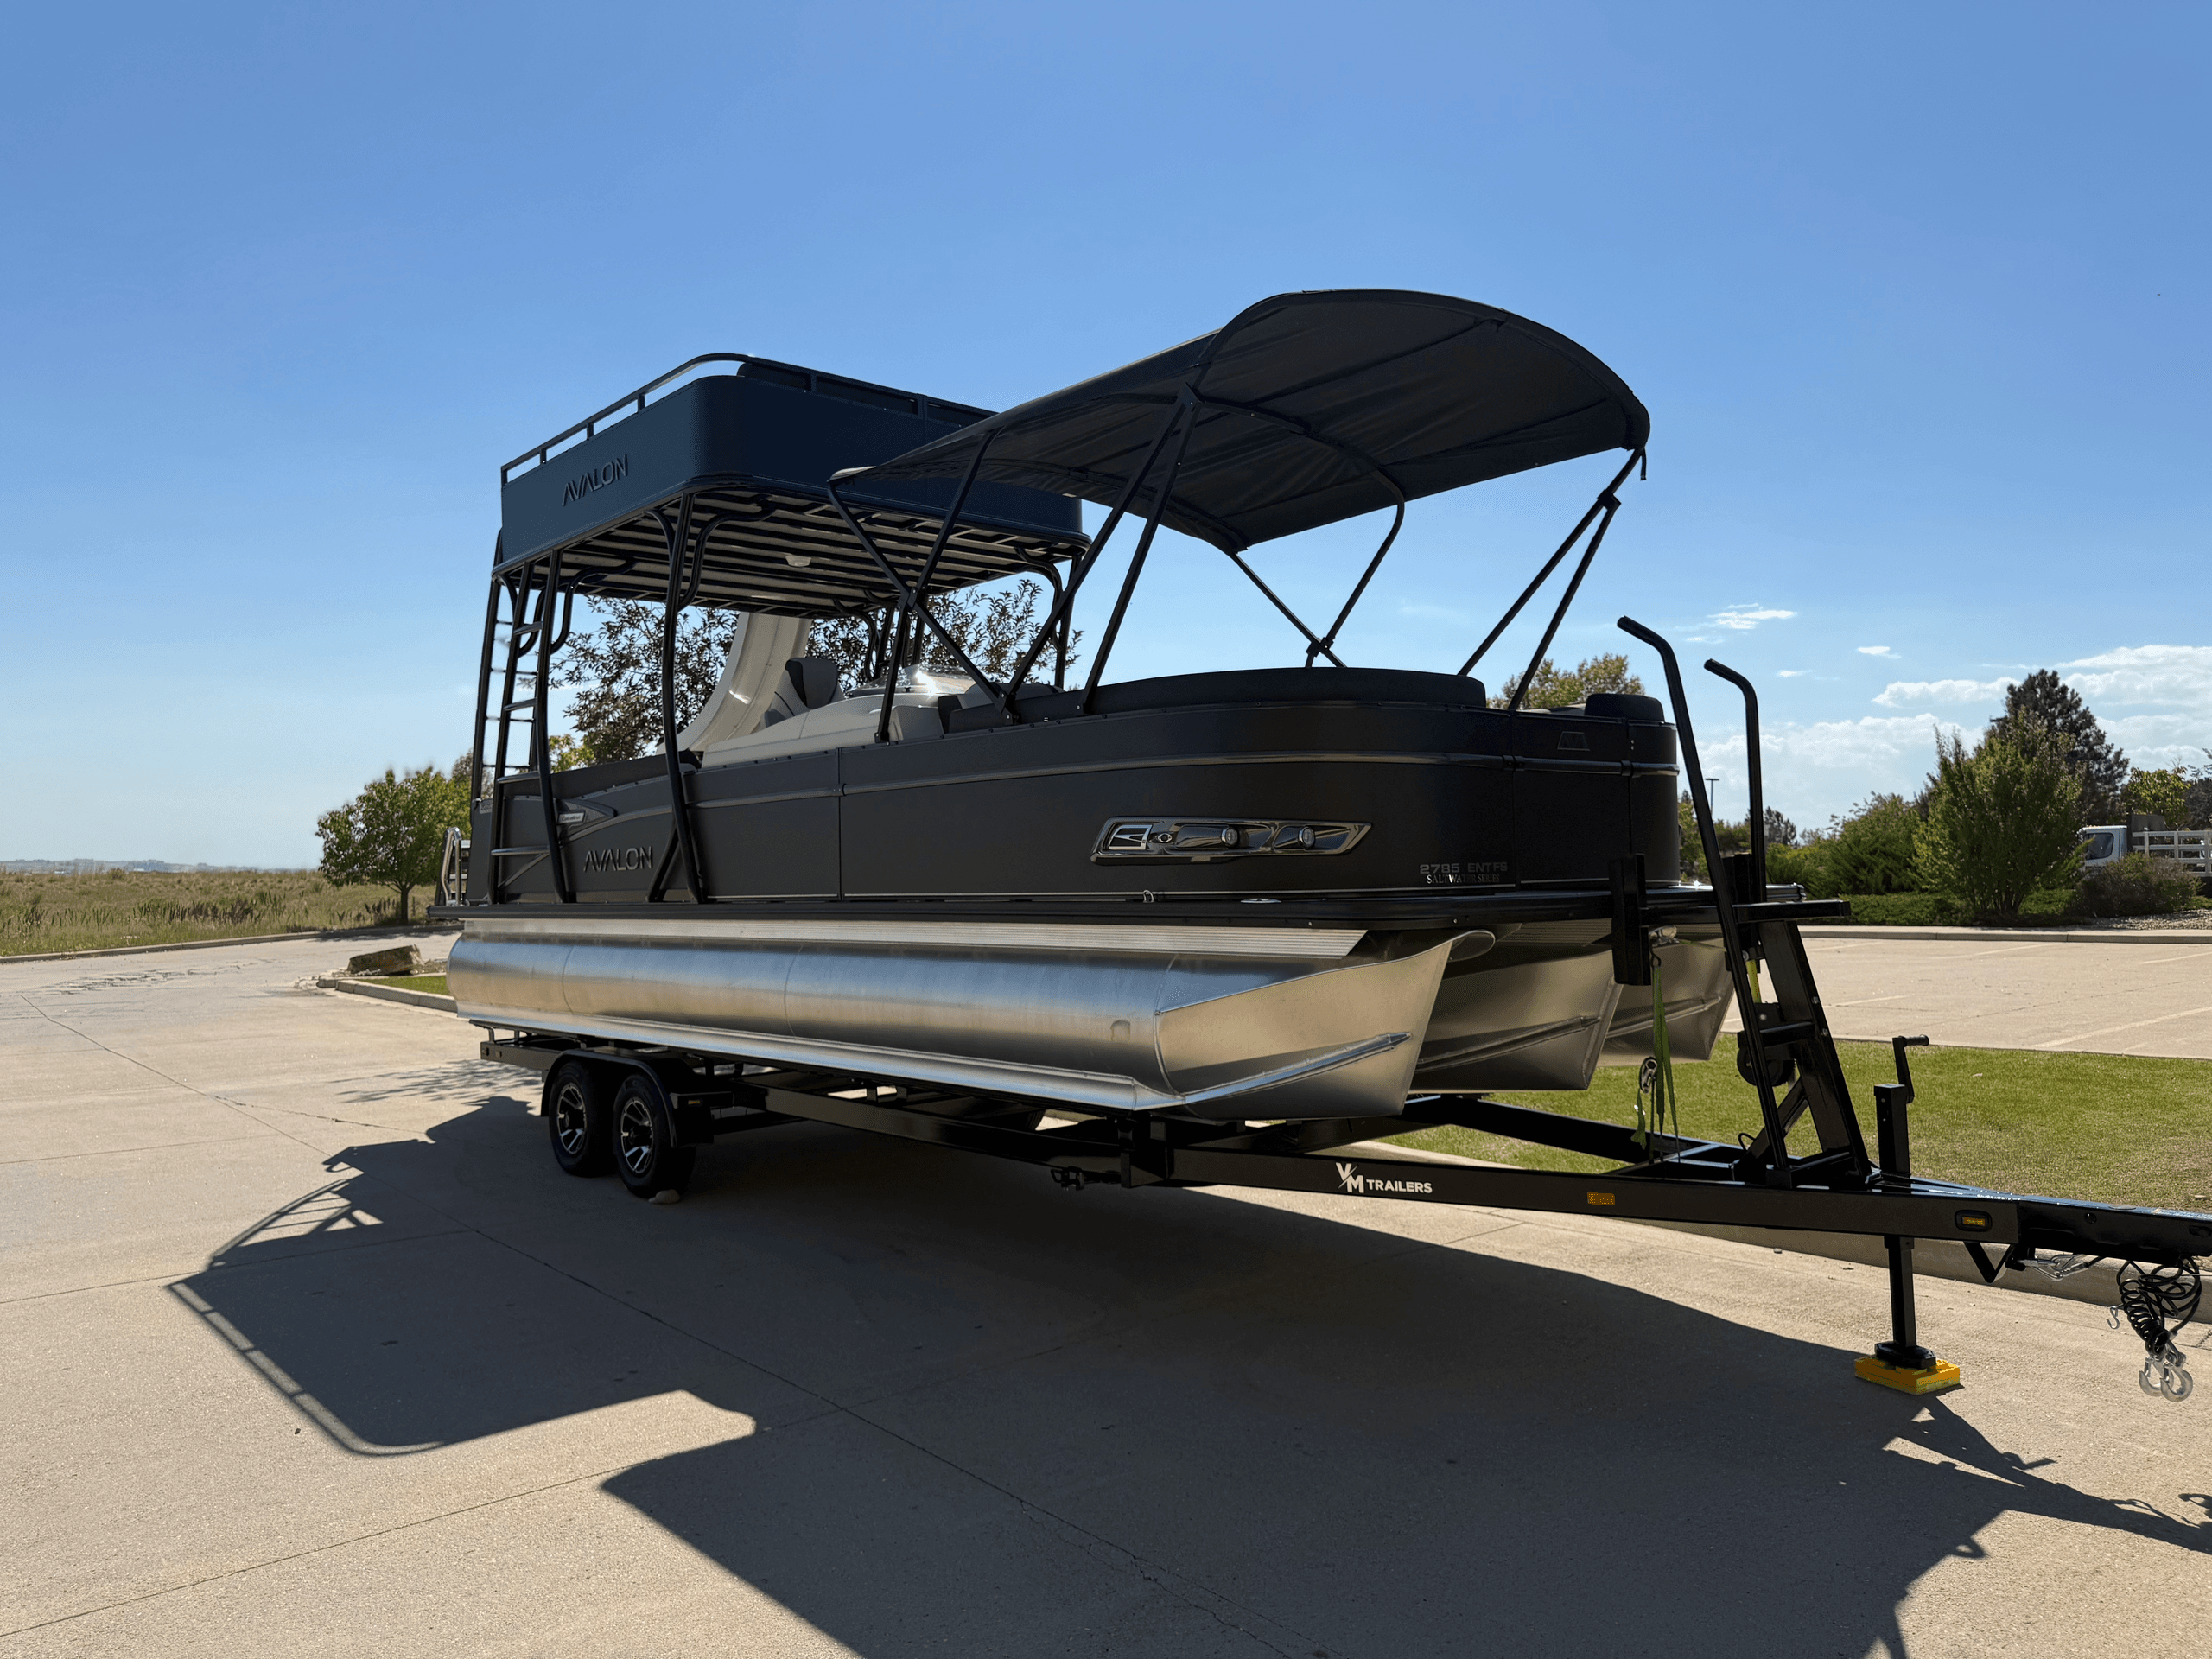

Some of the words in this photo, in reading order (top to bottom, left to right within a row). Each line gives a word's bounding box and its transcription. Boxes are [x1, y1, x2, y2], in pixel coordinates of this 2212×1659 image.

[562, 454, 628, 507] AVALON
[583, 845, 652, 872] AVALON
[1420, 862, 1460, 874] 2785
[1478, 873, 1500, 883] SERIES
[1365, 1179, 1433, 1194] TRAILERS
